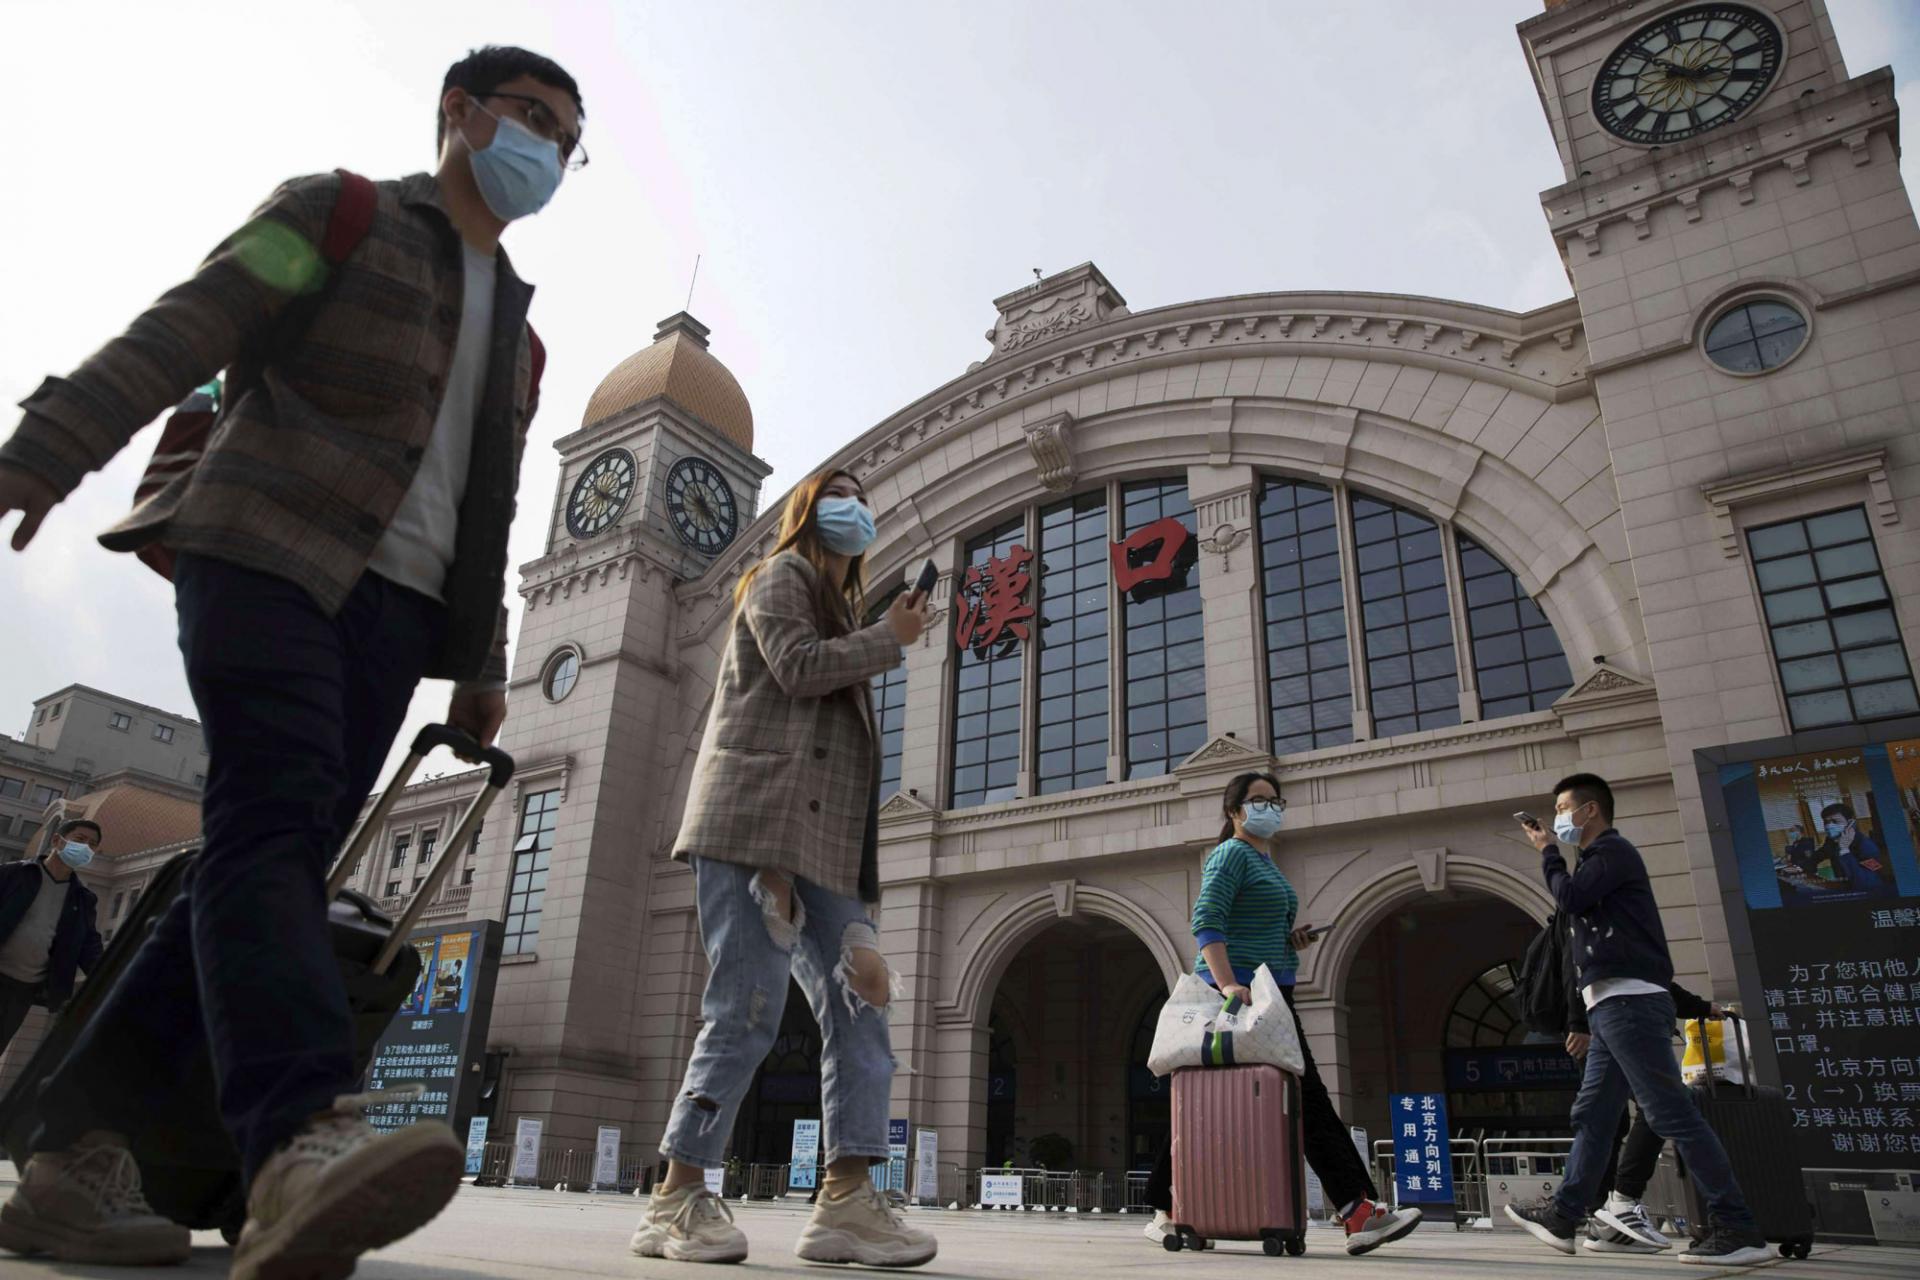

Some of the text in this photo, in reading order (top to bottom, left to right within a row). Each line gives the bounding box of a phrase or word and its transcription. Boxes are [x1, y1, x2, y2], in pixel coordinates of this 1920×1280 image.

[1769, 1008, 1920, 1031] 量，并注意排
[1465, 1060, 1481, 1082] 5
[1815, 1057, 1920, 1078] 北京方向
[994, 1077, 1005, 1096] 2
[1792, 1107, 1920, 1129] 务驿站联系
[1400, 1096, 1423, 1191] 专用通道
[1420, 1096, 1443, 1191] 北京方向列车
